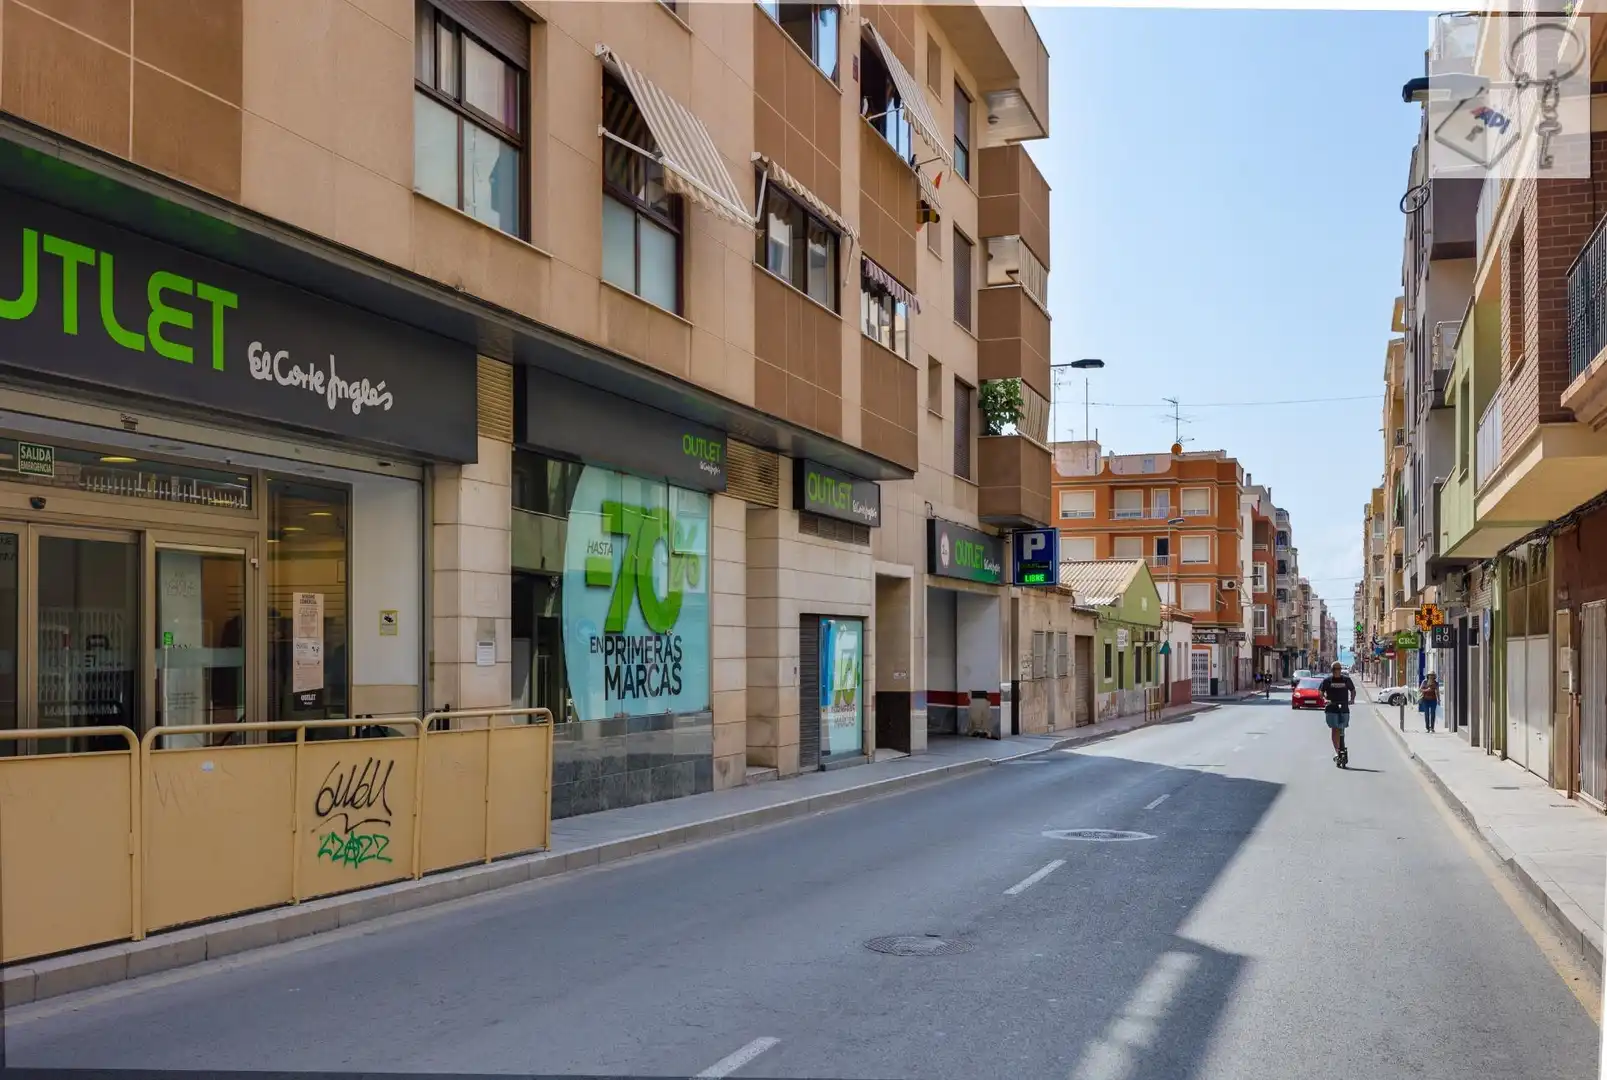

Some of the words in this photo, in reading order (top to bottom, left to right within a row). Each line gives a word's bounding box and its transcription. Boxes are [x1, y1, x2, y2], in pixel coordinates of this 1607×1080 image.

[247, 341, 273, 381] El
[273, 350, 325, 394] Corte
[327, 354, 393, 415] Inglés
[20, 445, 52, 462] SALIDA
[682, 434, 721, 463] OUTLET
[807, 471, 853, 514] OUTLET
[586, 538, 614, 556] HASTA
[954, 539, 985, 569] OUTLET
[1023, 532, 1046, 560] P
[1024, 573, 1045, 583] LIBRE
[590, 635, 604, 654] EN
[603, 635, 683, 665] PRIMERAS
[1398, 637, 1417, 645] CRC
[604, 663, 683, 701] MARCAS
